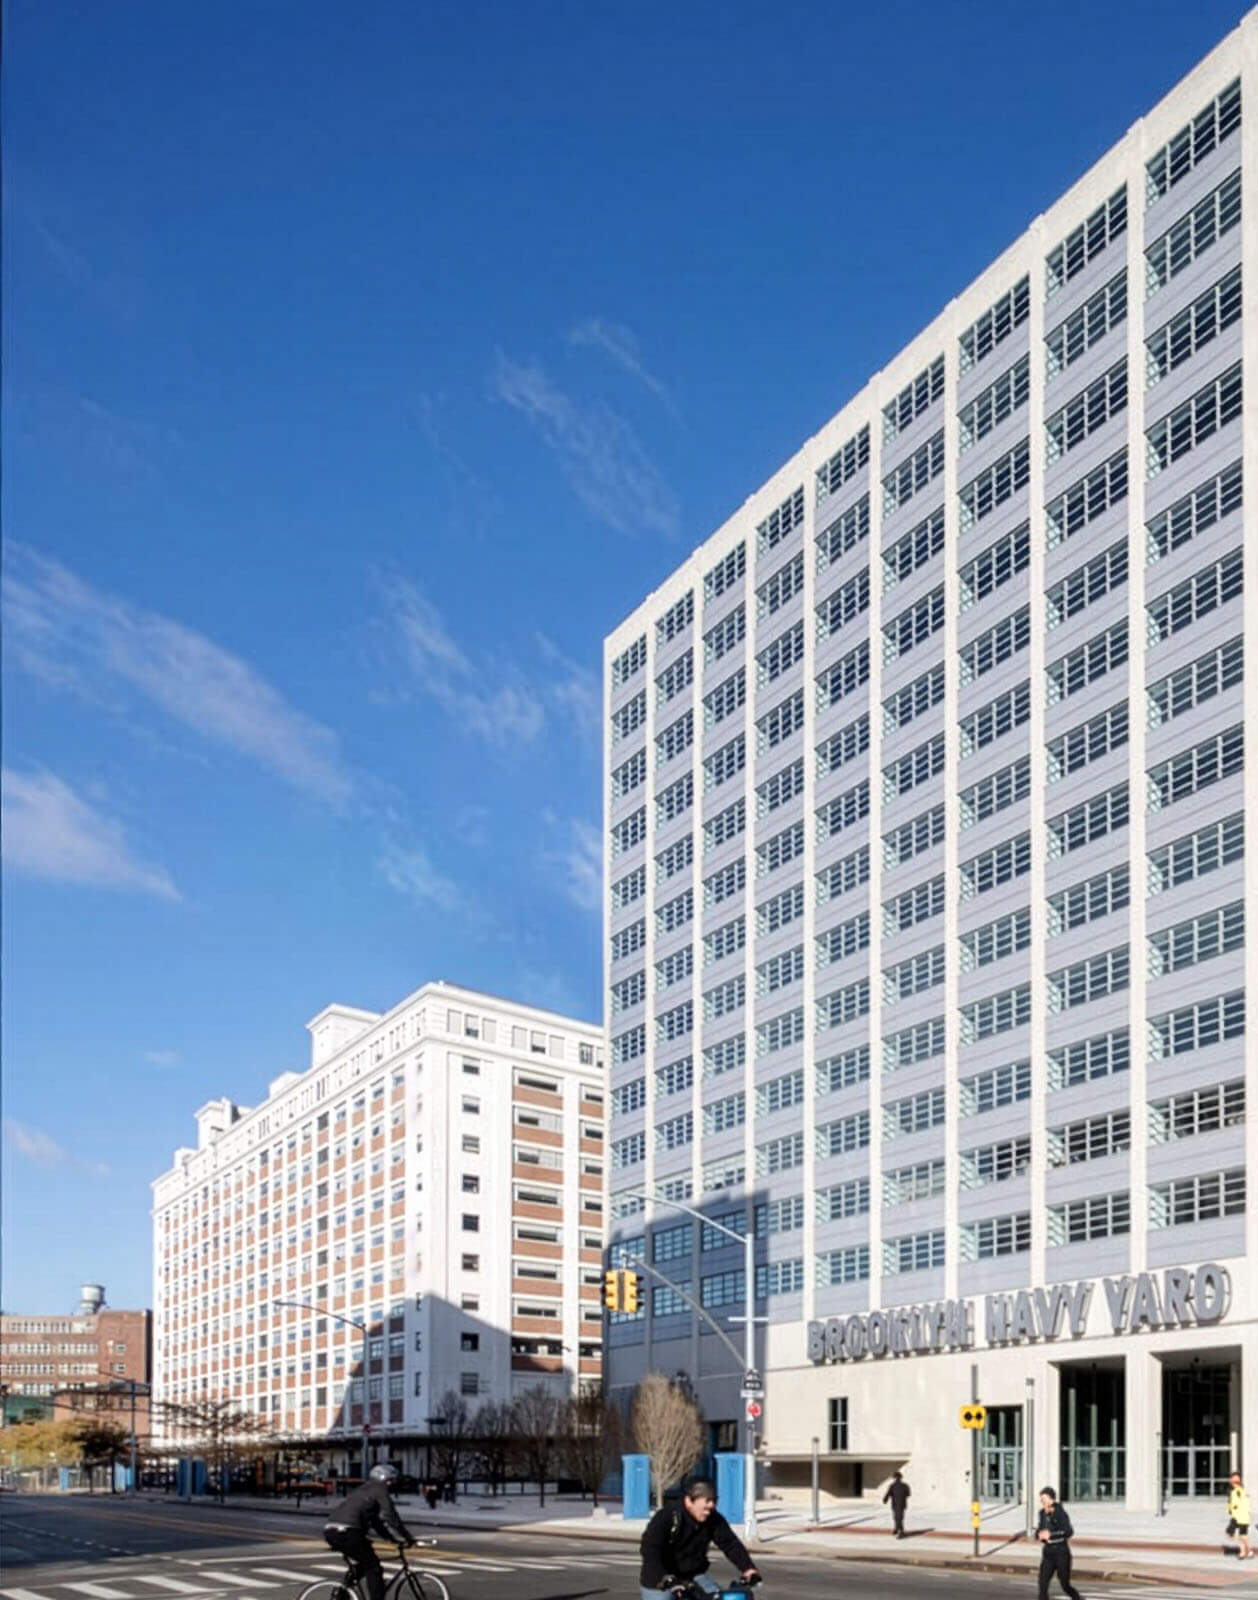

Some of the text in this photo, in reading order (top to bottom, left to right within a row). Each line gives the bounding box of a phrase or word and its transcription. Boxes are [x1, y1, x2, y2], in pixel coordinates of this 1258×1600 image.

[807, 1263, 1232, 1365] BROOKLYN NAVY YARD
